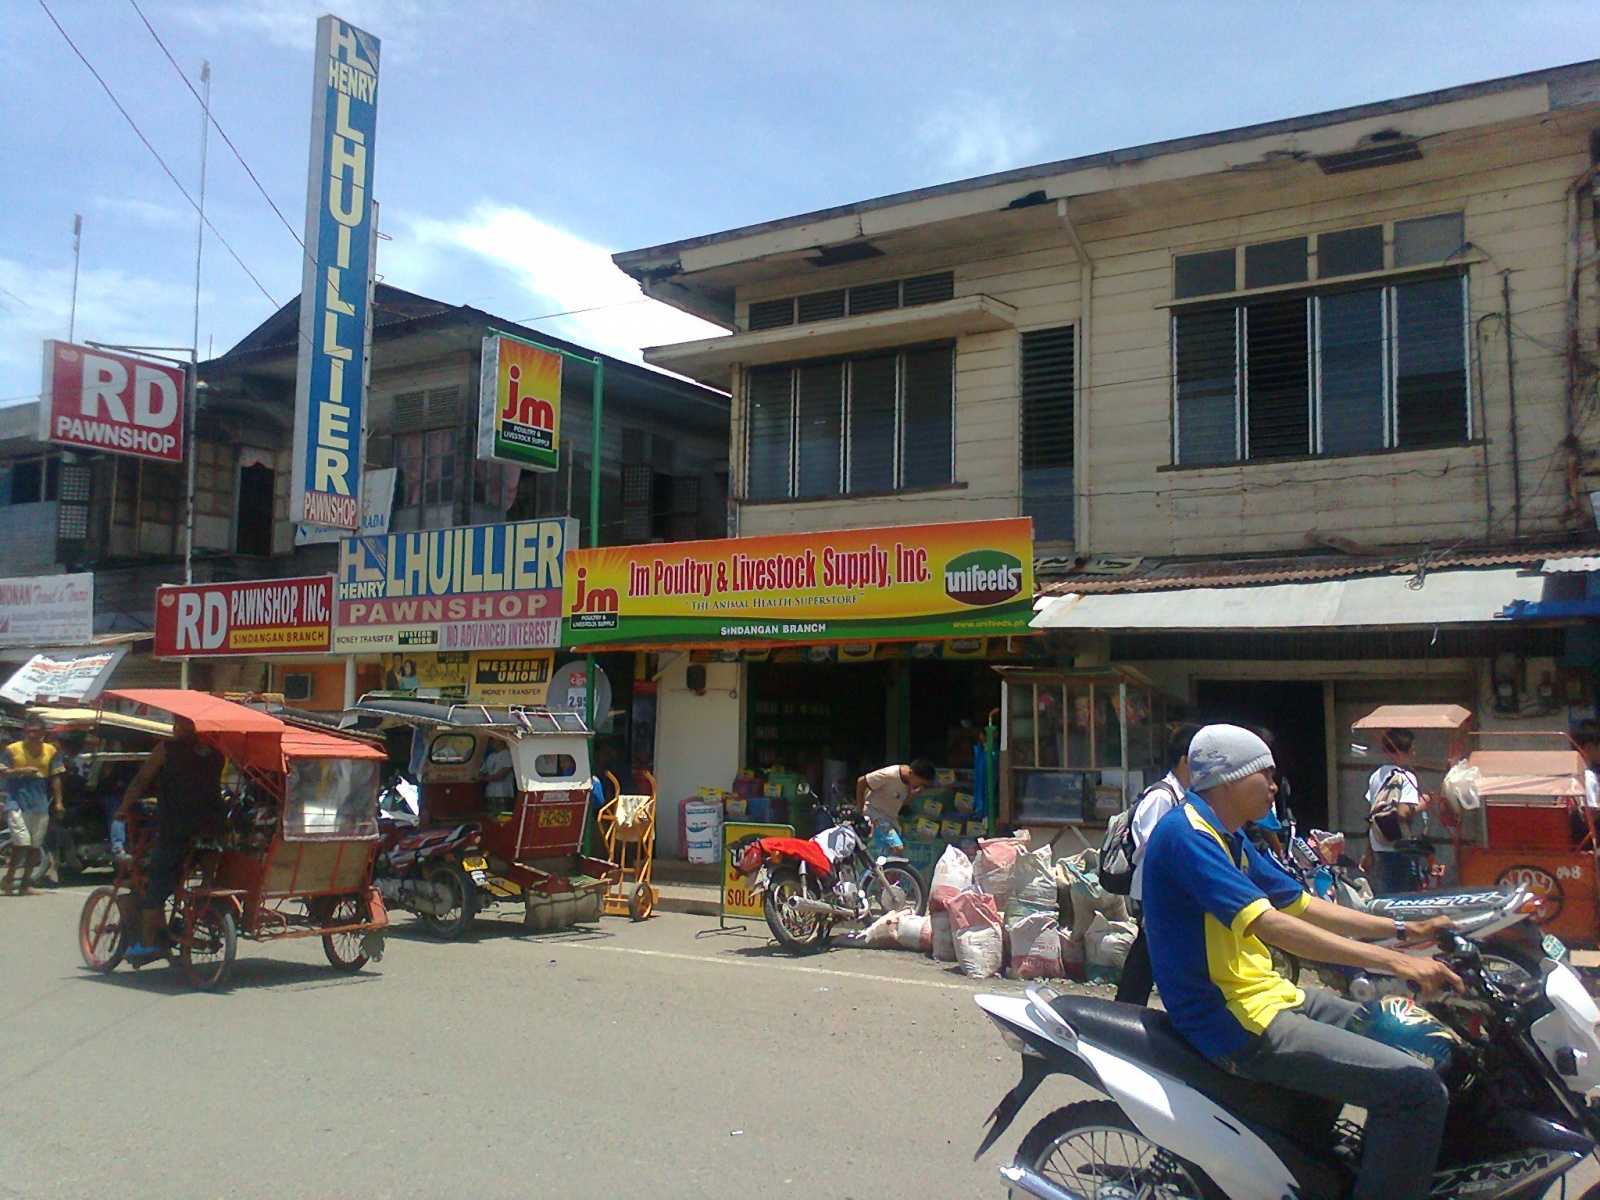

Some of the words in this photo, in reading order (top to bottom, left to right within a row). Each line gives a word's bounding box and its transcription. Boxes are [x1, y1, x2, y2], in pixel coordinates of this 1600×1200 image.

[328, 58, 378, 105] HENRY
[315, 92, 366, 495] LHUILLIER
[81, 353, 178, 429] RD
[502, 365, 553, 430] jm
[57, 415, 176, 454] PAWNSHOP
[304, 491, 357, 526] PAWNSHOP
[386, 521, 563, 597] LHUILLIER
[628, 561, 650, 598] Jm
[653, 558, 713, 598] Poultry
[716, 561, 728, 594] &
[732, 549, 817, 592] Livestock
[822, 545, 892, 590] Supply,
[896, 543, 931, 584] Inc.
[339, 580, 386, 600] HENRY
[571, 567, 618, 613] jm
[946, 564, 1020, 593] unifeeds
[176, 591, 228, 651] RD
[231, 585, 298, 627] PAWNSHOP,
[303, 583, 330, 622] INC.
[350, 594, 548, 624] PAWNSHOP
[233, 633, 284, 645] SINDANGAN
[286, 631, 324, 644] BRANCH
[337, 636, 358, 644] MONEY
[360, 634, 394, 644] TRANSFER
[446, 625, 459, 648] NO
[460, 621, 506, 648] ADVANCED
[720, 624, 779, 636] SINDANGAN
[782, 622, 827, 635] BRANCH
[478, 660, 539, 672] WESTERN
[497, 671, 538, 683] UNION
[508, 688, 541, 696] TRANSFER
